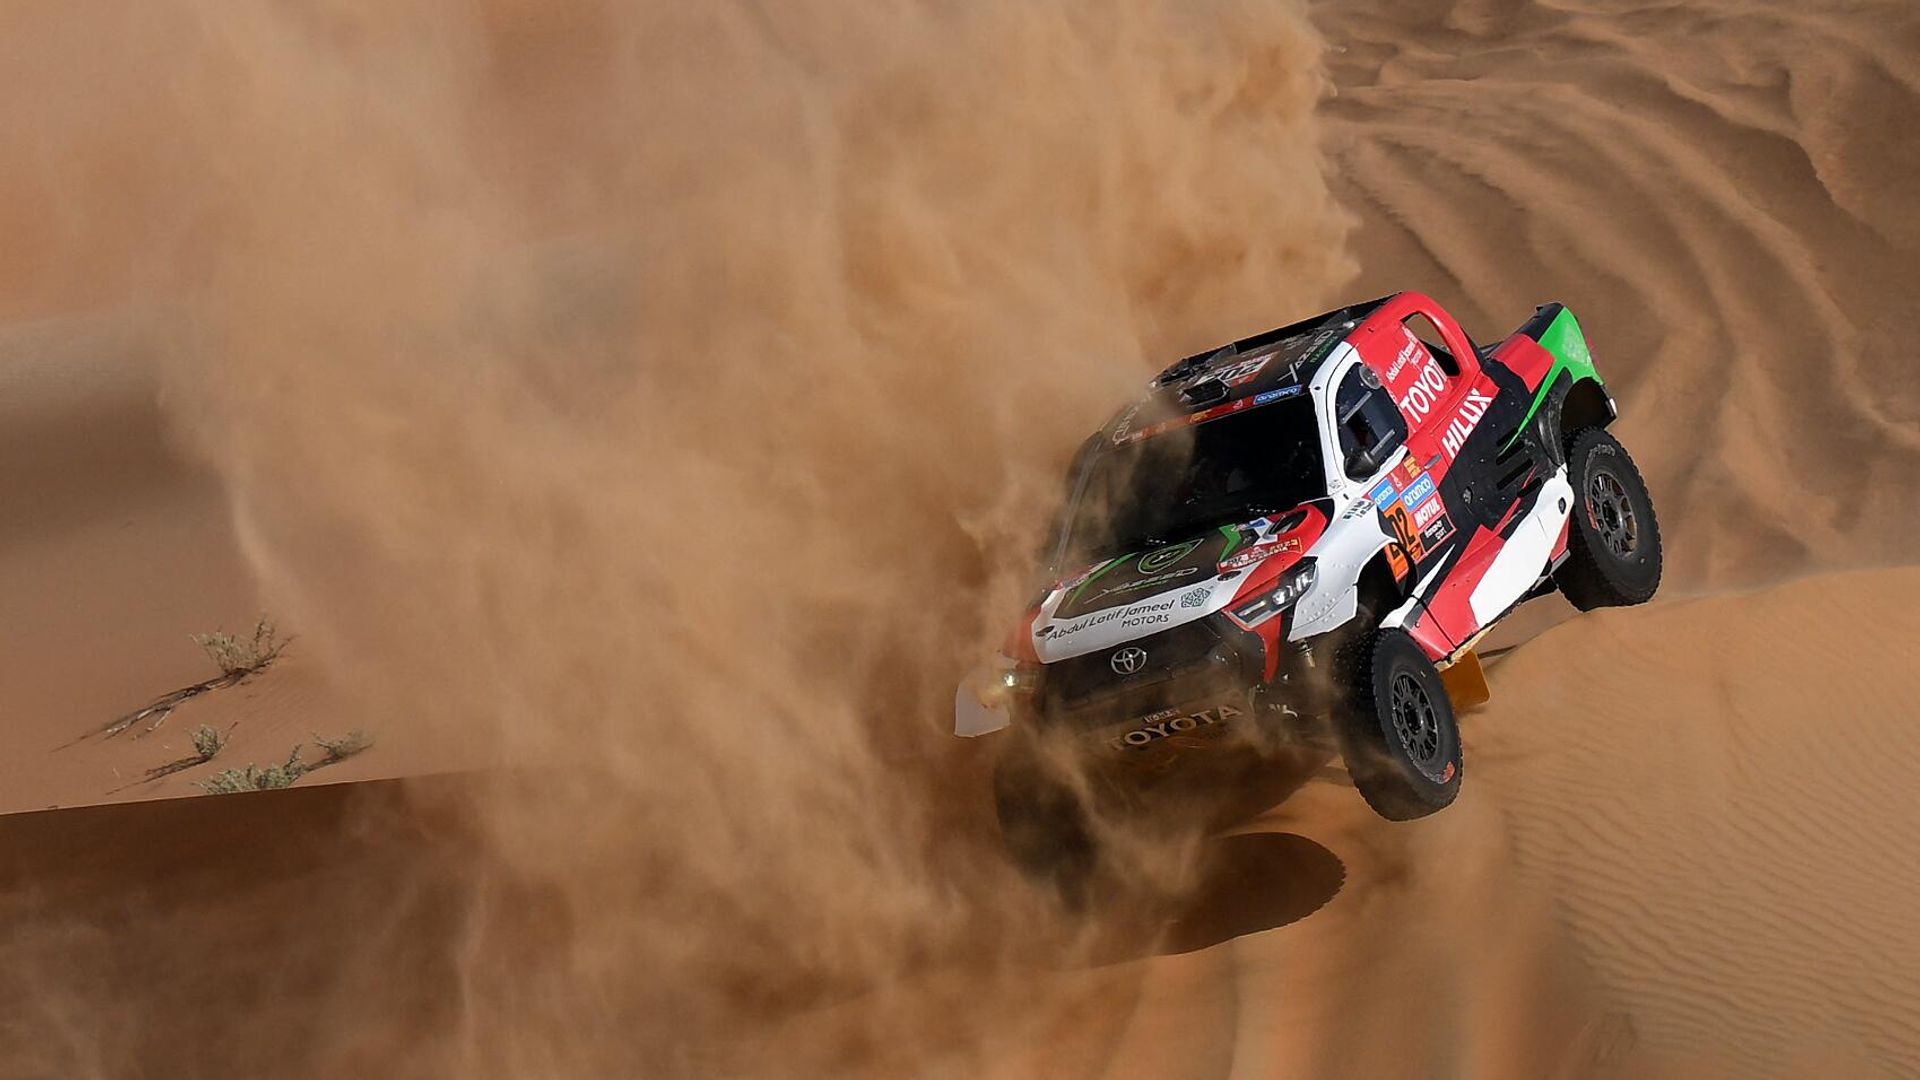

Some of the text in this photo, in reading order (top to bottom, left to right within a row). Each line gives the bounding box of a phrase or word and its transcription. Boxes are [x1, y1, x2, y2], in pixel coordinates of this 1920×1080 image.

[1441, 388, 1493, 461] HILUX
[1403, 478, 1433, 506] aramco
[1414, 500, 1441, 528] MOTUL
[1047, 599, 1176, 642] Abdul Latif Jameel
[1121, 613, 1170, 629] MOTORS
